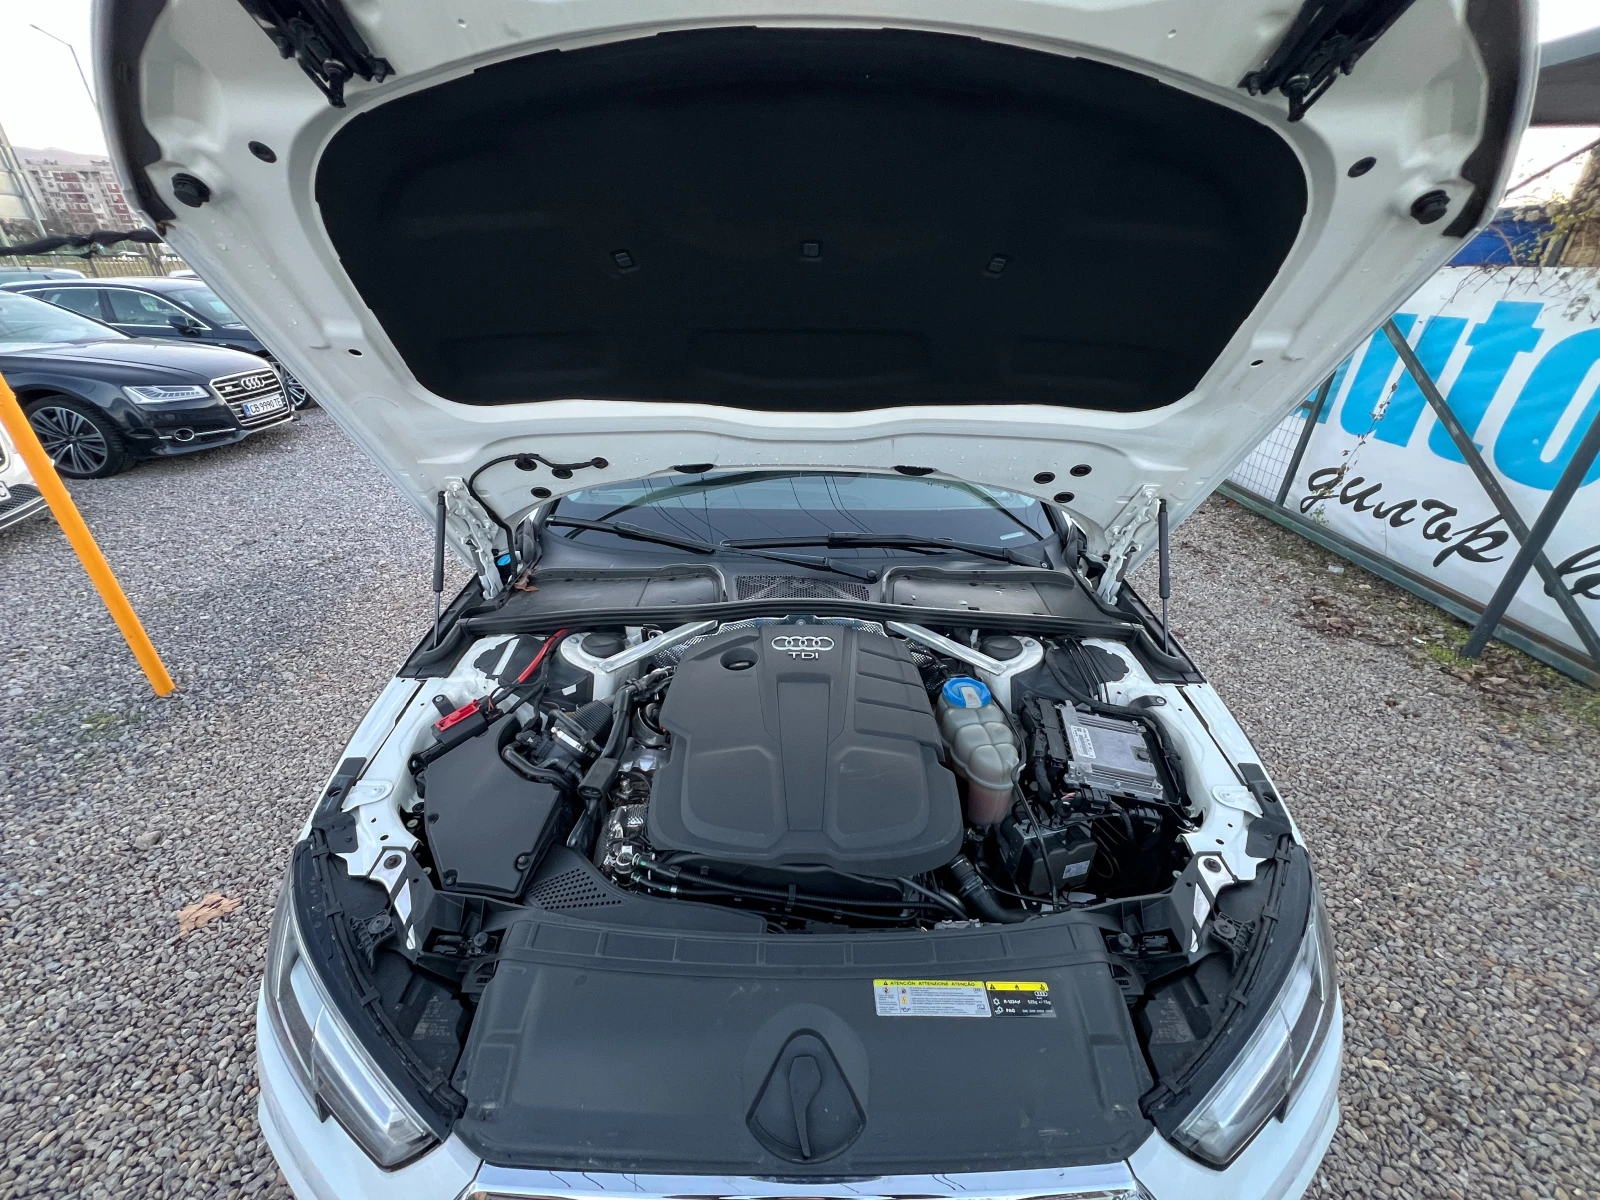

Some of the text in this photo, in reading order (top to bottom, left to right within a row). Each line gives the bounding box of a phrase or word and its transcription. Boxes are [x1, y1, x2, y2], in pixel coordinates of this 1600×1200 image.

[250, 403, 260, 413] CB
[260, 400, 274, 411] 9990
[788, 651, 819, 659] TDI
